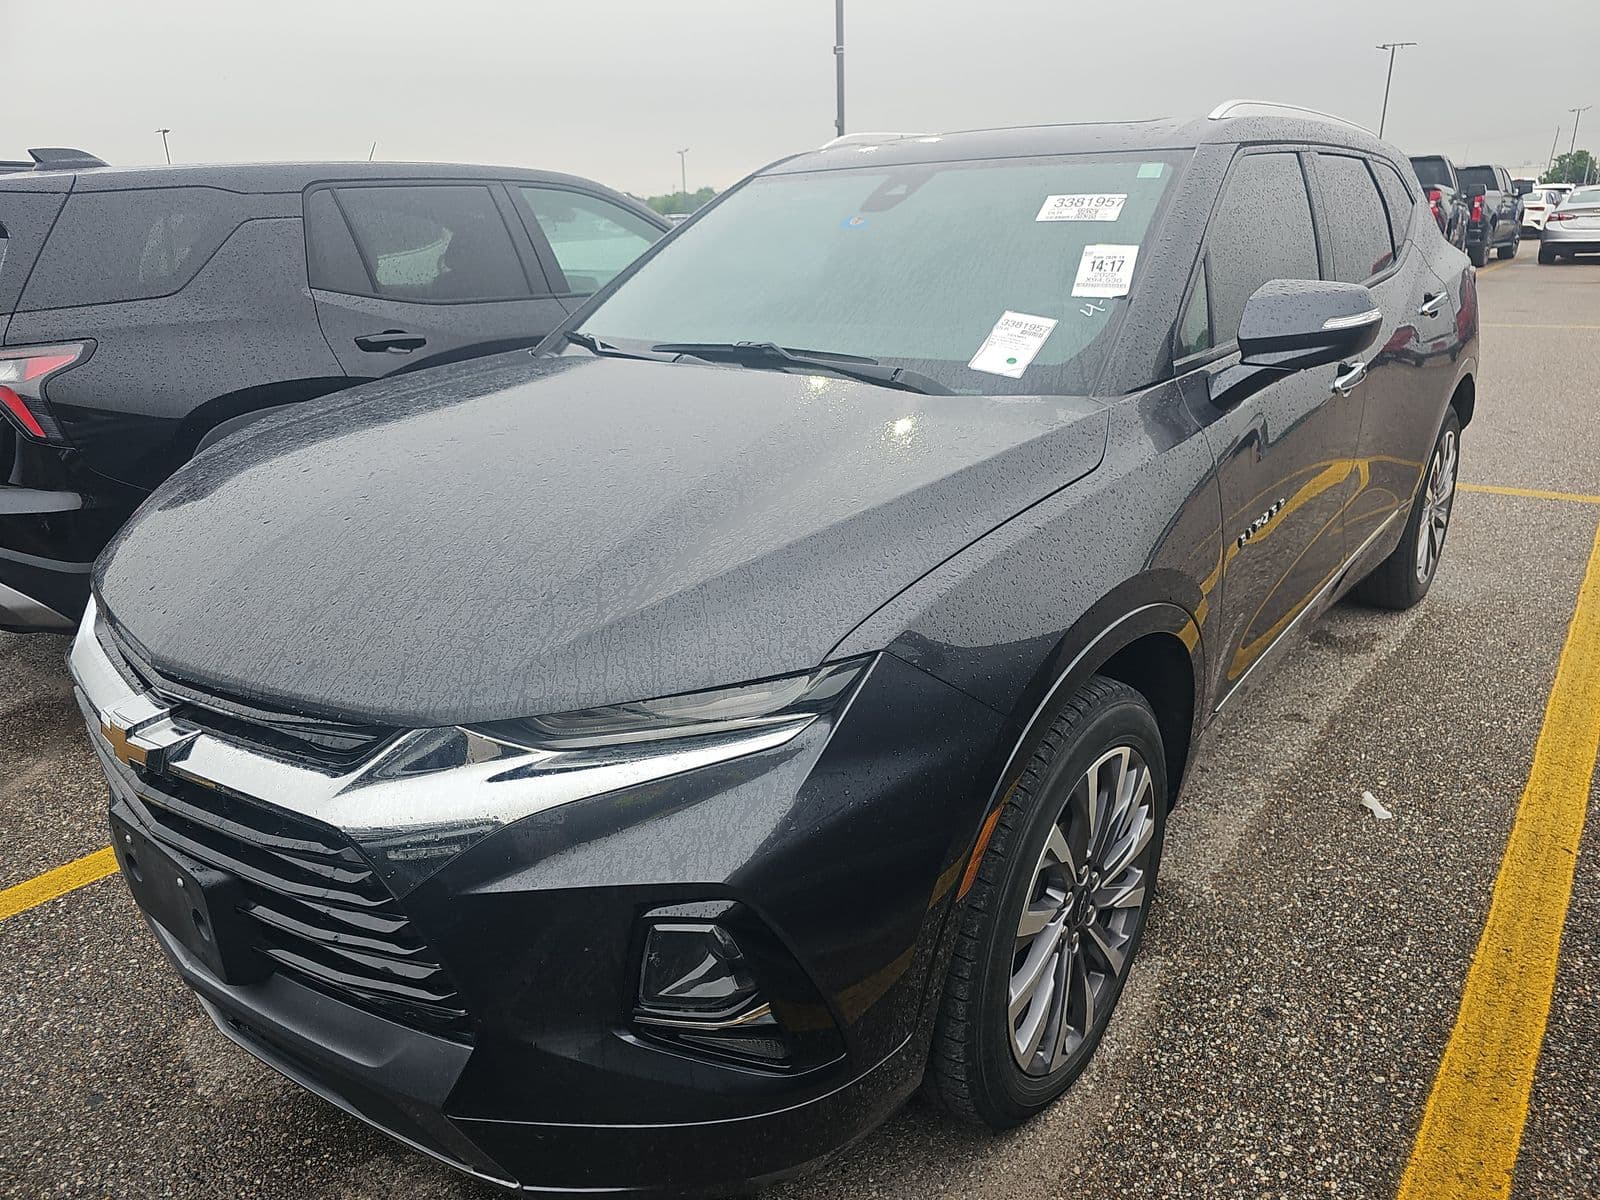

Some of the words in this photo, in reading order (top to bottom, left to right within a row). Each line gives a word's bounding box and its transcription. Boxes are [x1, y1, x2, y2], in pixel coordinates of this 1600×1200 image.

[1054, 197, 1126, 208] 3381957
[1090, 260, 1125, 272] 14:17
[1001, 318, 1051, 334] 3381957
